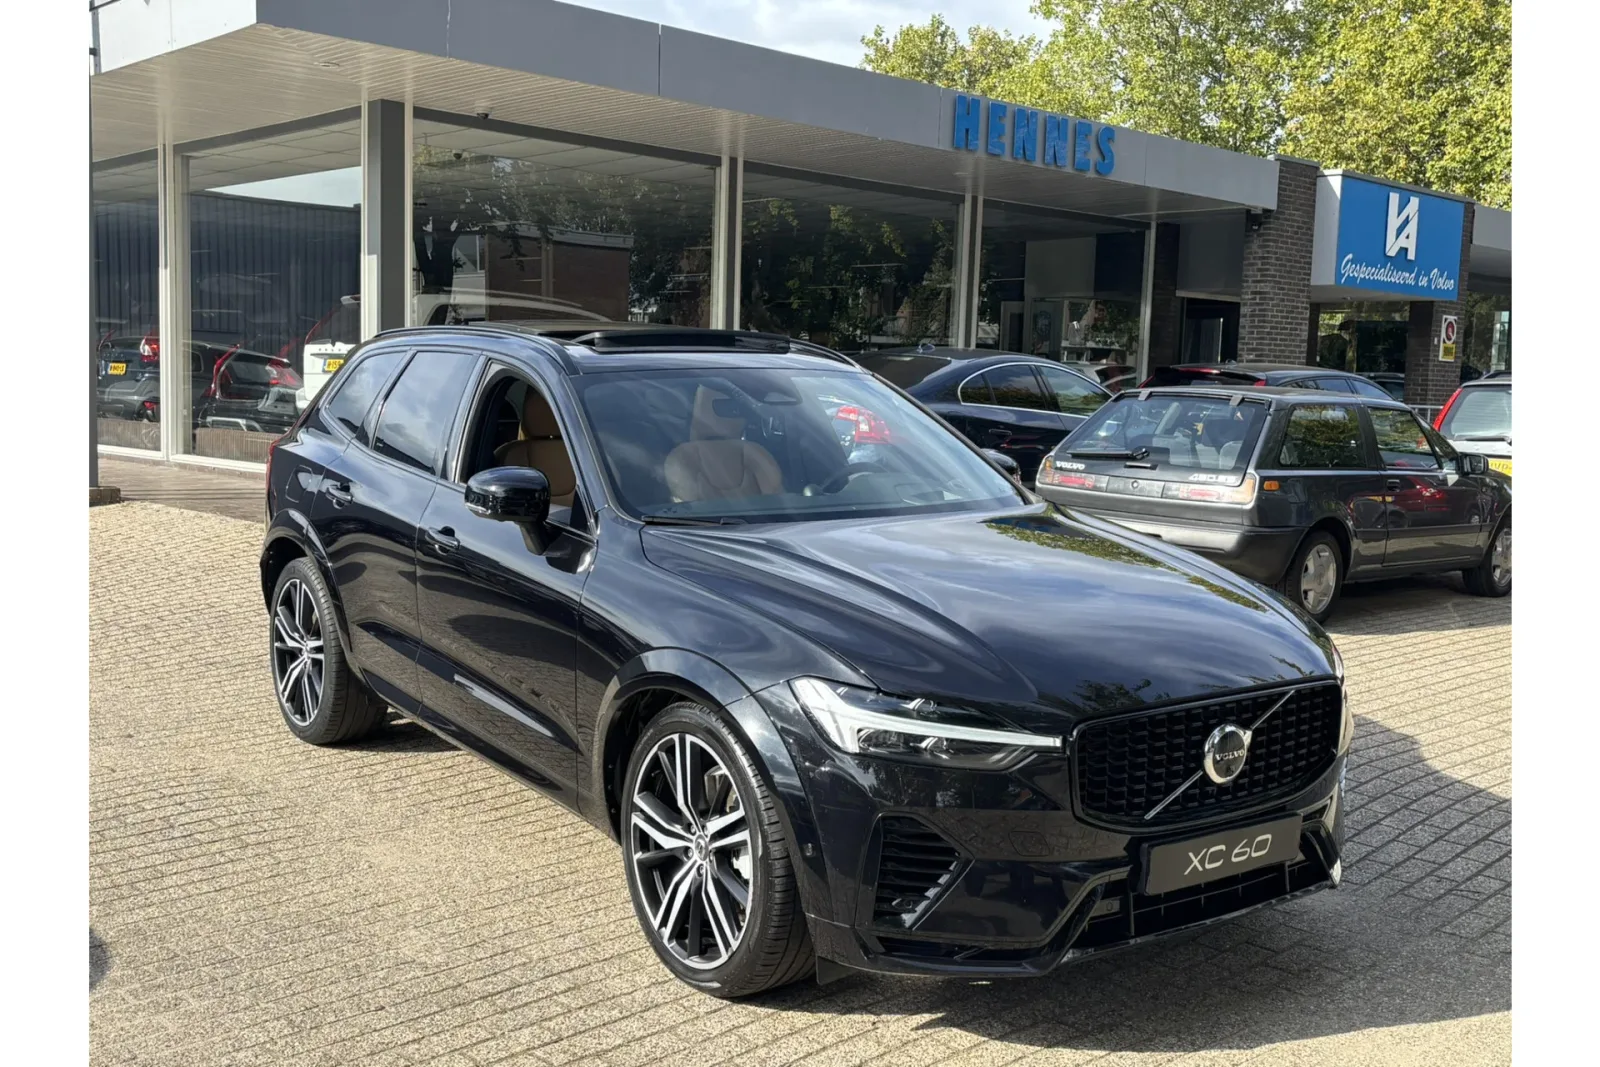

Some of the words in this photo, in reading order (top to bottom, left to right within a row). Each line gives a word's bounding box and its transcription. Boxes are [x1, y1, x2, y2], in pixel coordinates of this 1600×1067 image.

[954, 94, 1116, 176] HENNES
[1340, 253, 1417, 285] Gespecialiseerd
[1418, 270, 1428, 288] in
[1430, 267, 1455, 291] Volvo
[1055, 460, 1086, 470] VOLVO
[1215, 749, 1245, 761] VOLVO
[1184, 844, 1226, 876] XC
[1231, 833, 1272, 863] 60
